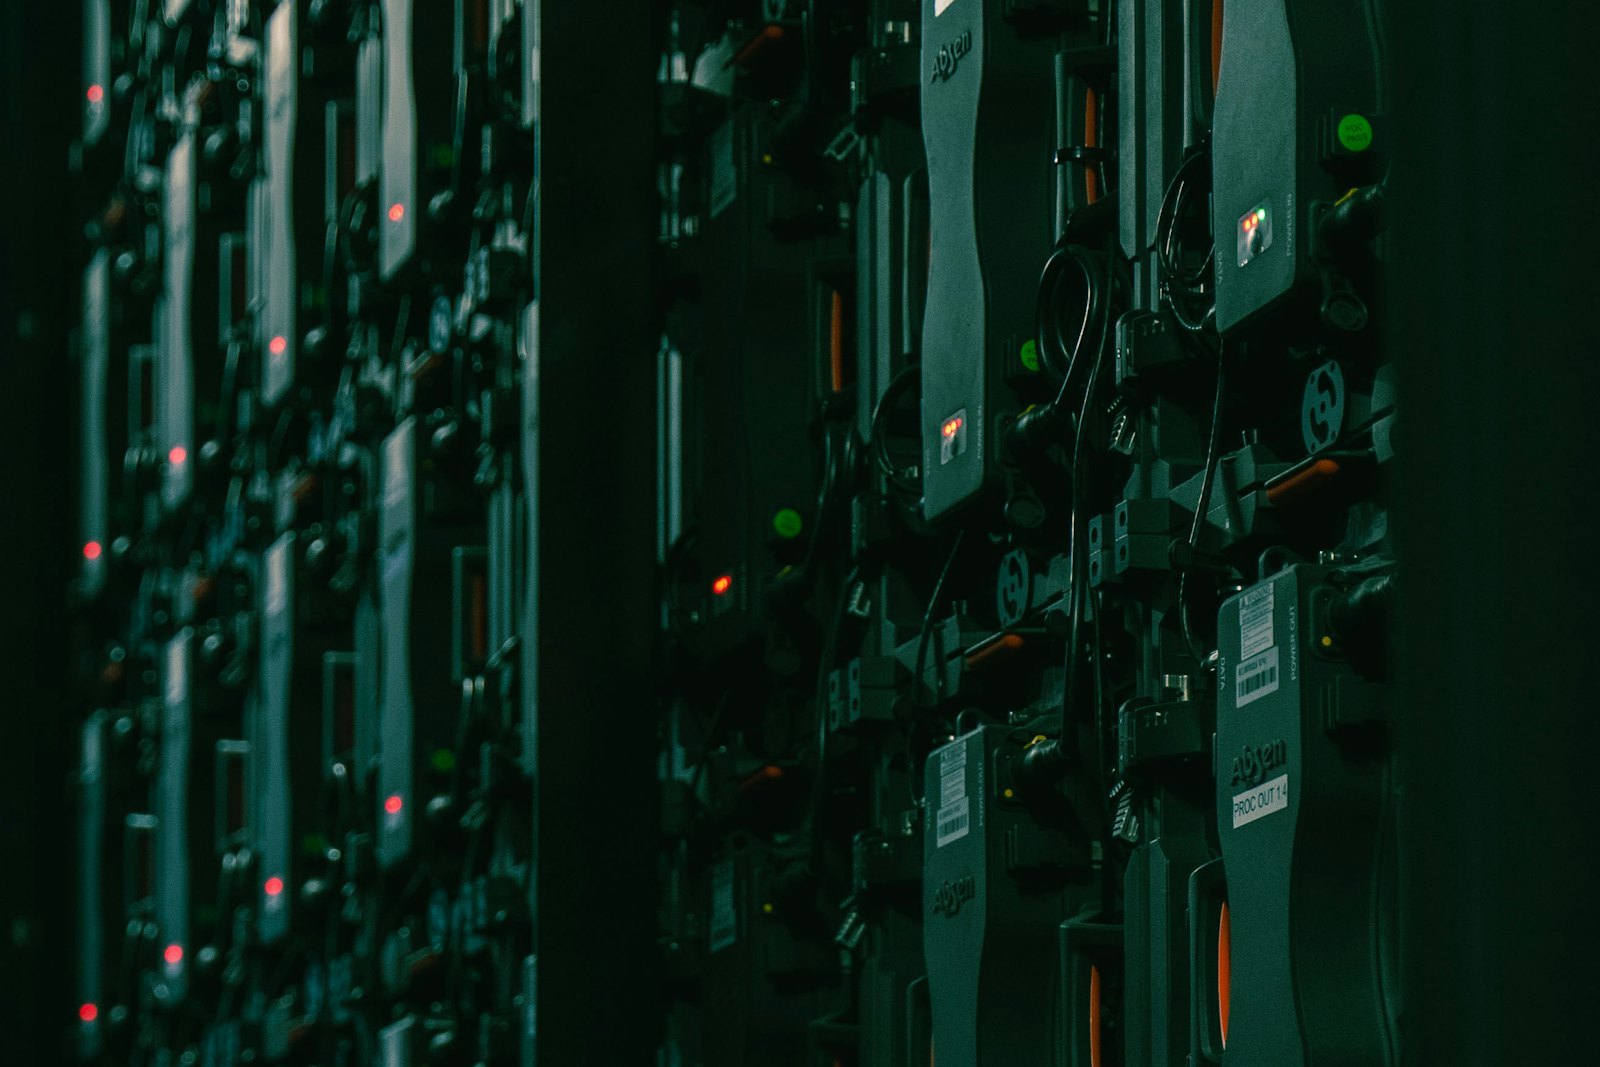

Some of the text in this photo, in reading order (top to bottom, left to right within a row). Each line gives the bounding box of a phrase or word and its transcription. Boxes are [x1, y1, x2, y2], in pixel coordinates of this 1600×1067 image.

[931, 31, 971, 82] Absen
[1231, 740, 1286, 786] Absen
[1234, 796, 1256, 818] PROC
[1258, 787, 1274, 808] OUT
